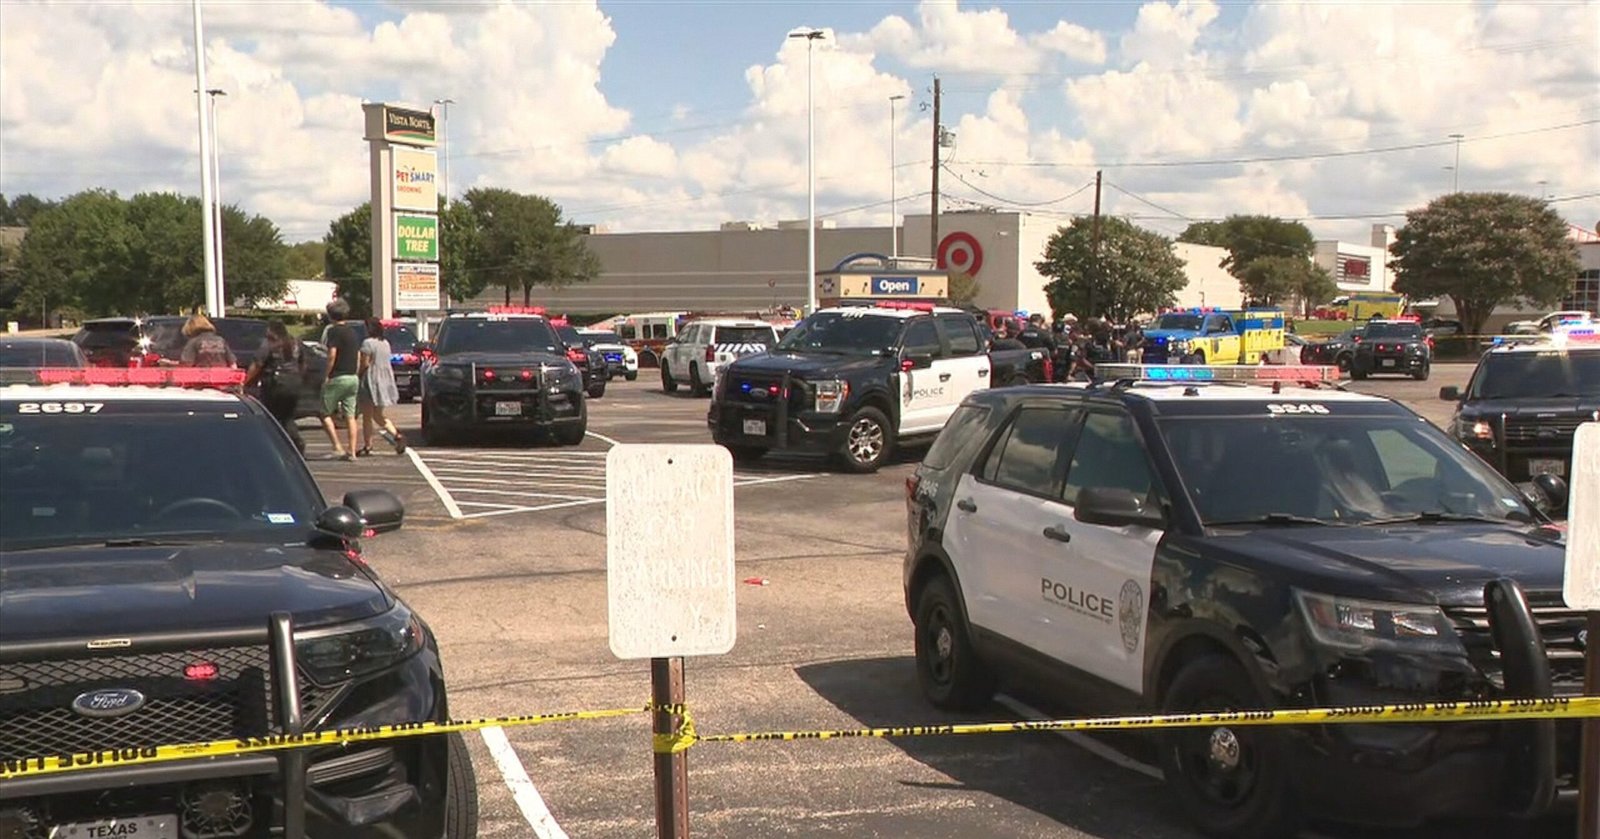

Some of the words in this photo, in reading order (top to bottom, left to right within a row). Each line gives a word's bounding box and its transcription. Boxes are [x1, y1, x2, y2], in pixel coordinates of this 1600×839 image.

[398, 225, 435, 240] DOLLAR
[405, 239, 429, 252] TREE
[879, 279, 910, 293] Open
[913, 387, 944, 397] POLICE
[1041, 577, 1114, 618] POLICE
[90, 692, 129, 709] Ford
[87, 822, 137, 838] TEXAS
